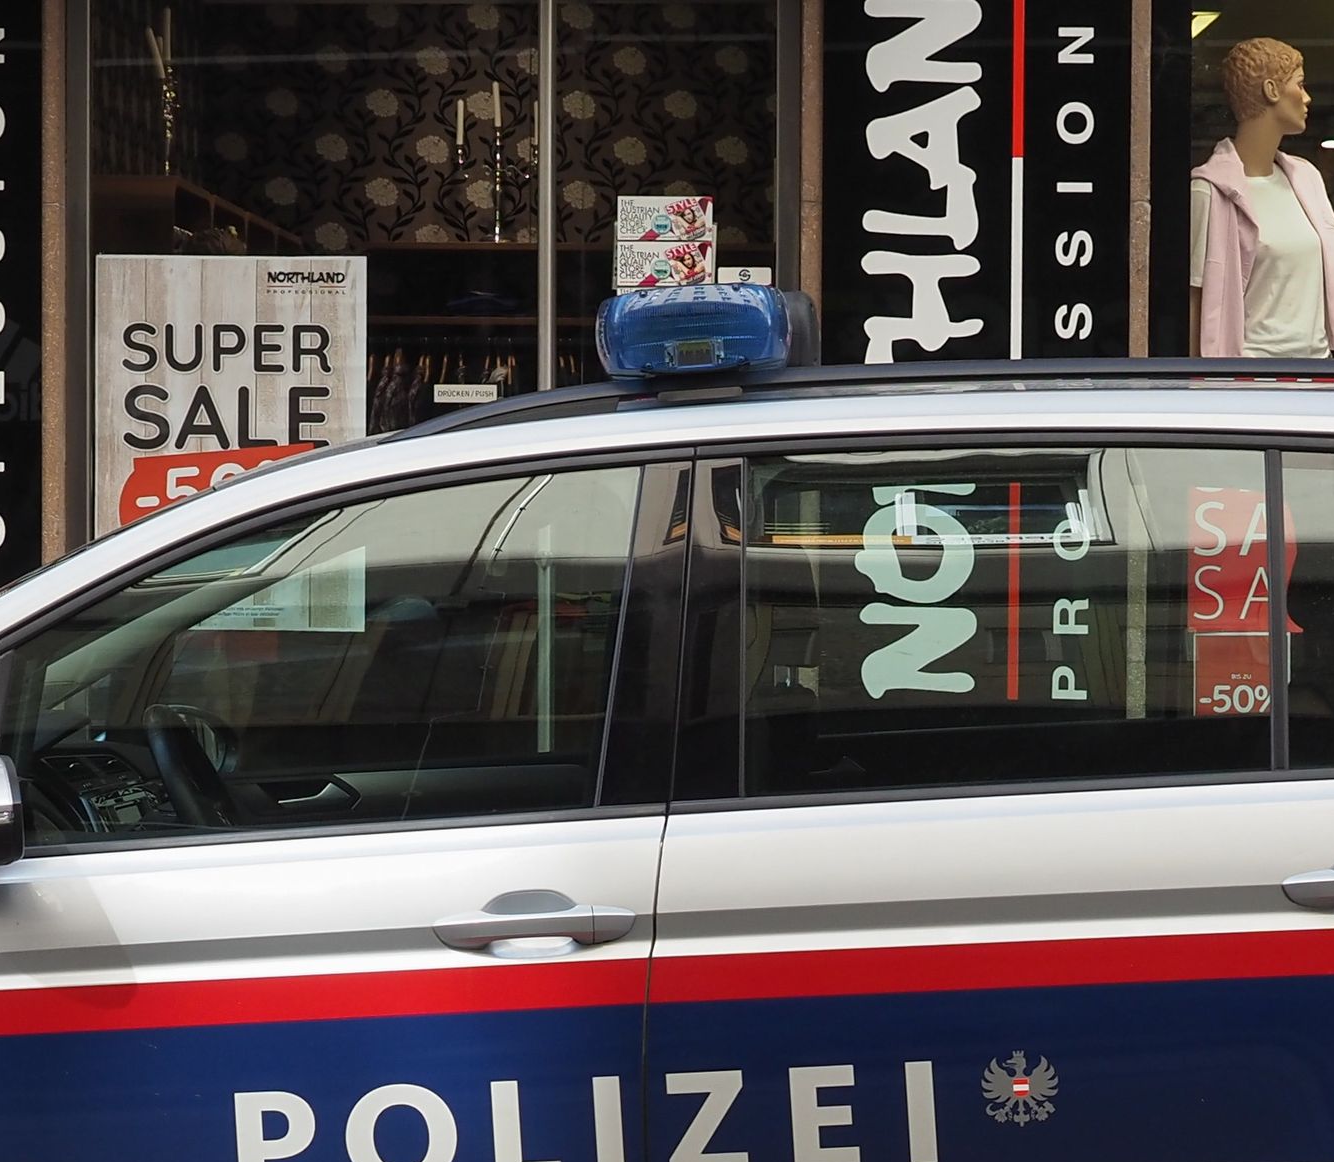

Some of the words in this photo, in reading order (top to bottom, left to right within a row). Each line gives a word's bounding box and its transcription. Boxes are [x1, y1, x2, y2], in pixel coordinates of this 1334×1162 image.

[666, 197, 698, 214] STYLE
[620, 213, 654, 221] QUALITY
[620, 220, 645, 228] STORE
[619, 251, 660, 259] AUSTRIAN
[665, 243, 697, 259] STYLE
[619, 258, 654, 266] QUALITY
[619, 265, 645, 273] STORE
[267, 271, 346, 284] NORTHLAND
[123, 323, 332, 372] SUPER
[437, 389, 470, 397] DRÜCKEN
[476, 390, 494, 398] PUSH
[123, 385, 330, 450] SALE
[854, 483, 977, 699] NO
[1199, 684, 1271, 714] -50%
